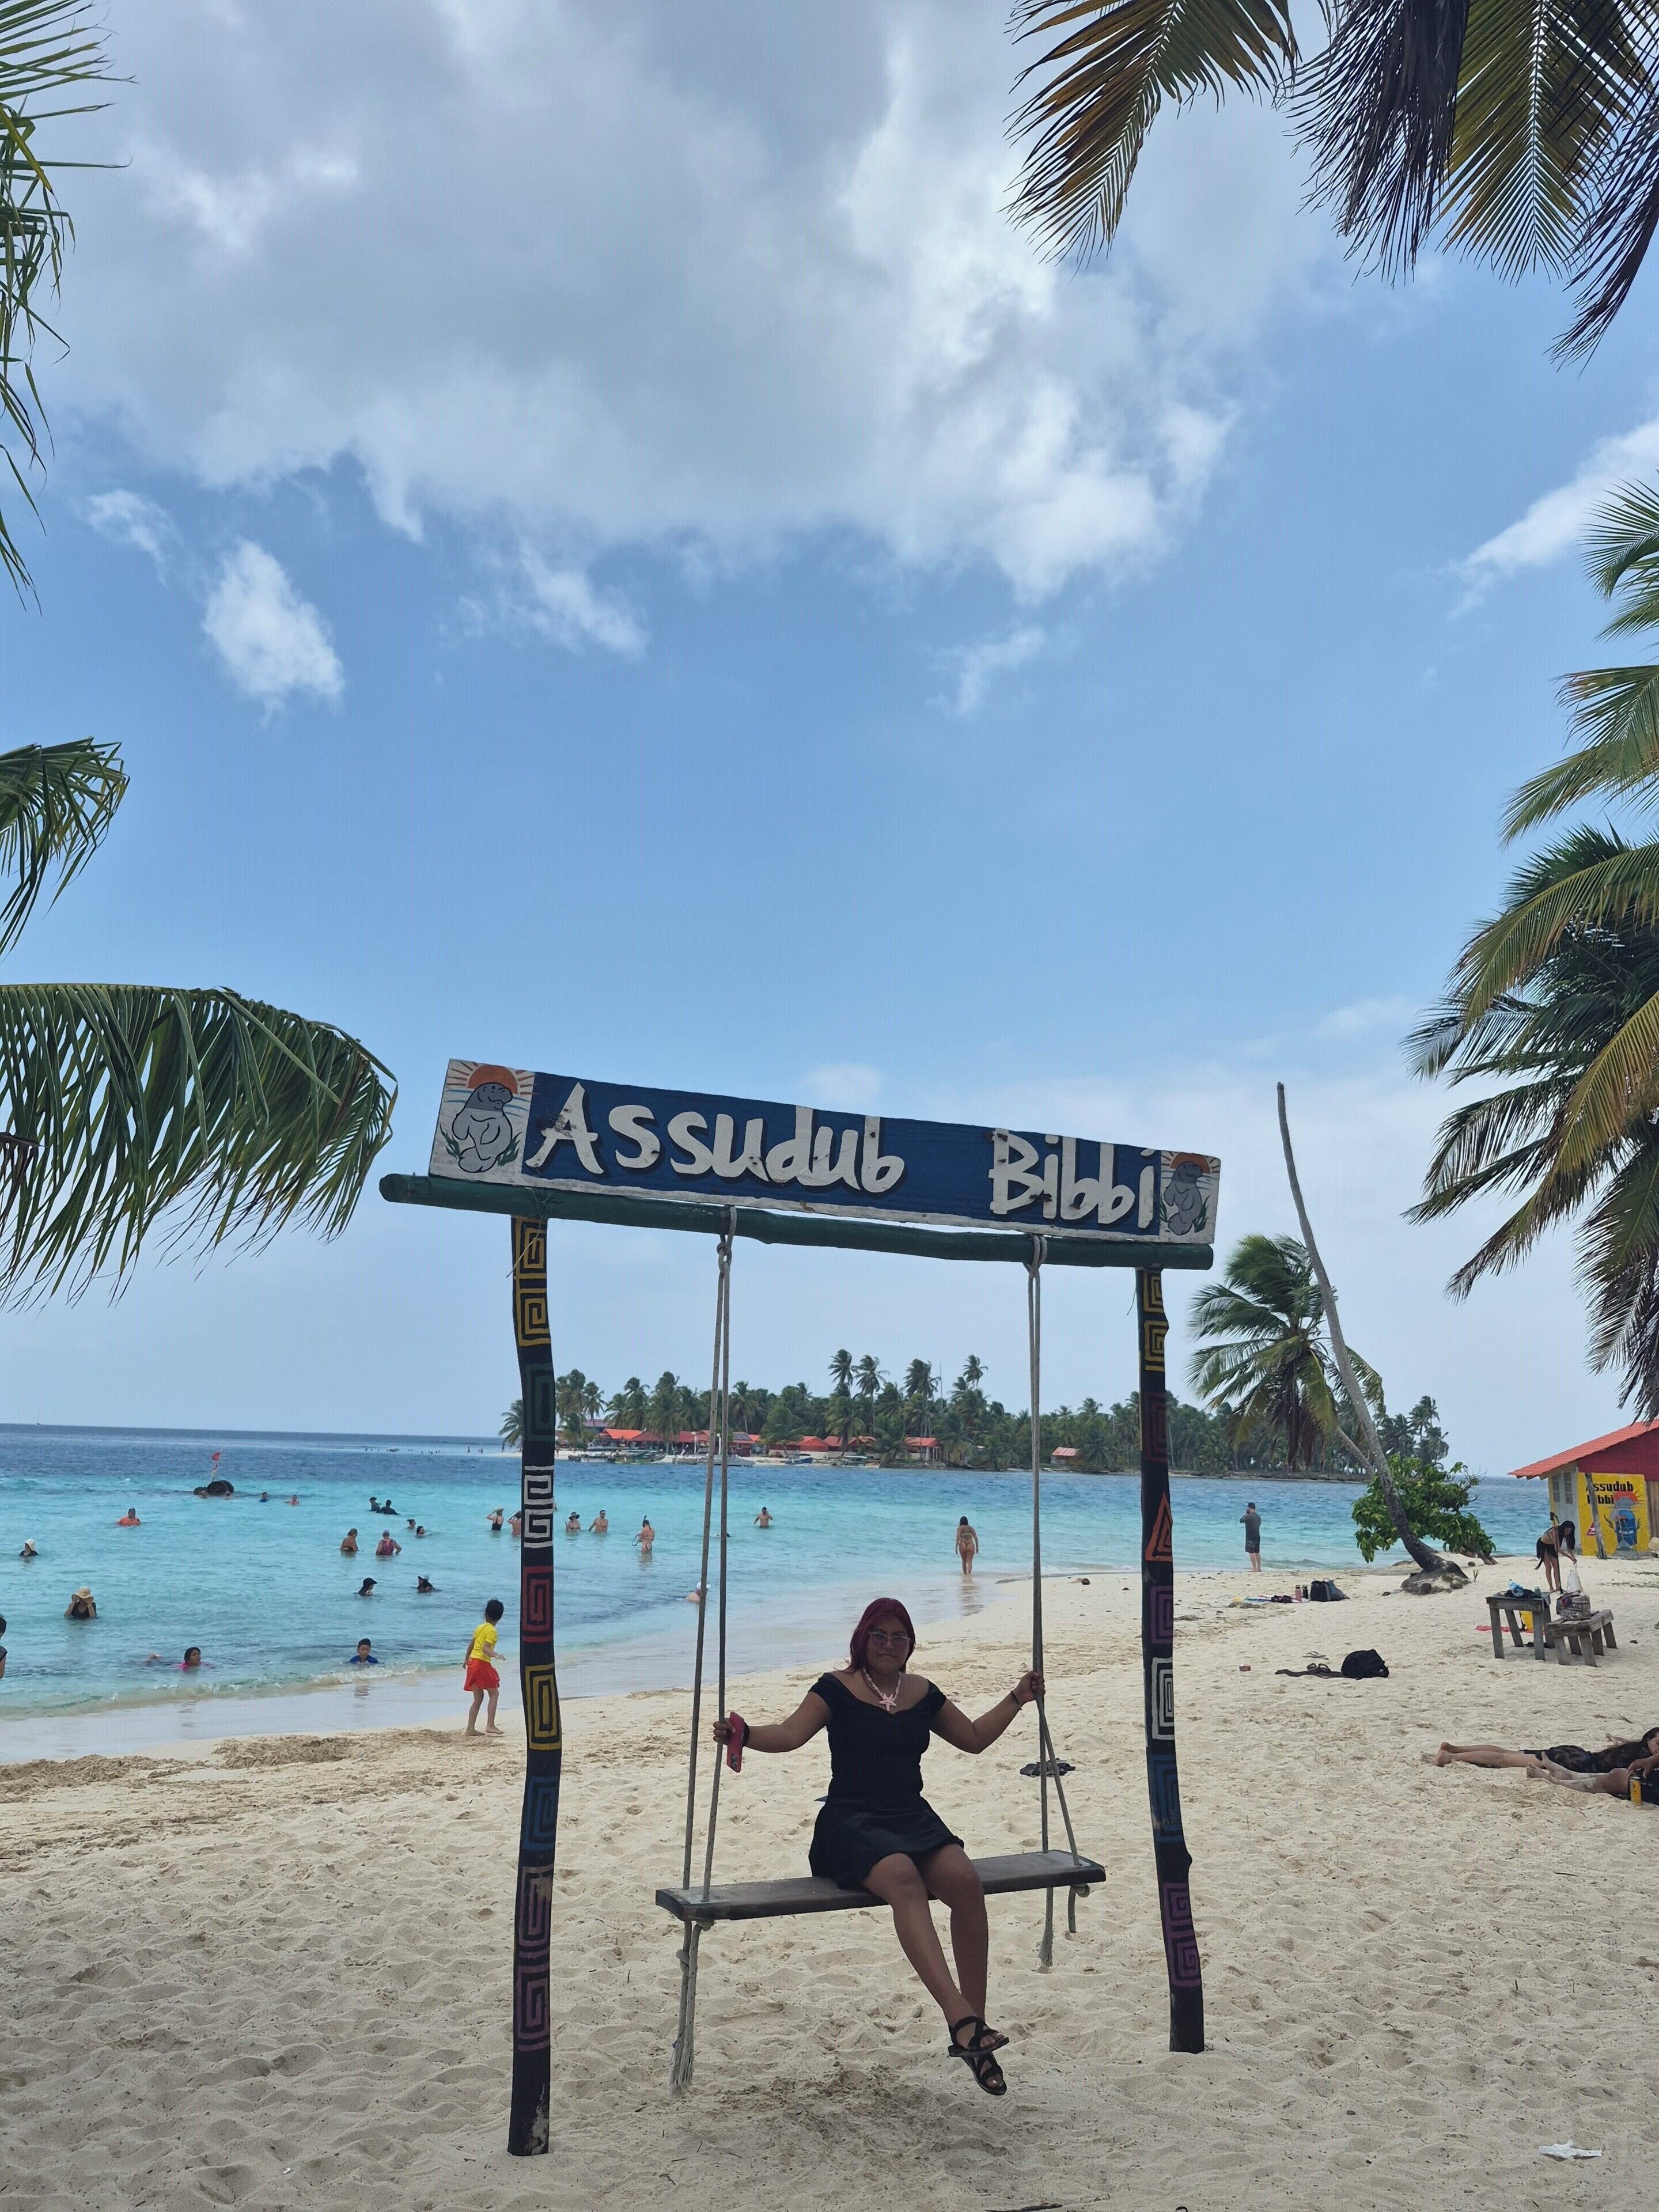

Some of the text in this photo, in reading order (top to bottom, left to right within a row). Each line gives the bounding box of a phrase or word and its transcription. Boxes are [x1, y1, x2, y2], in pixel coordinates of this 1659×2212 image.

[525, 1082, 1155, 1229] Assudub Bibbi
[1586, 1494, 1614, 1505] bbi
